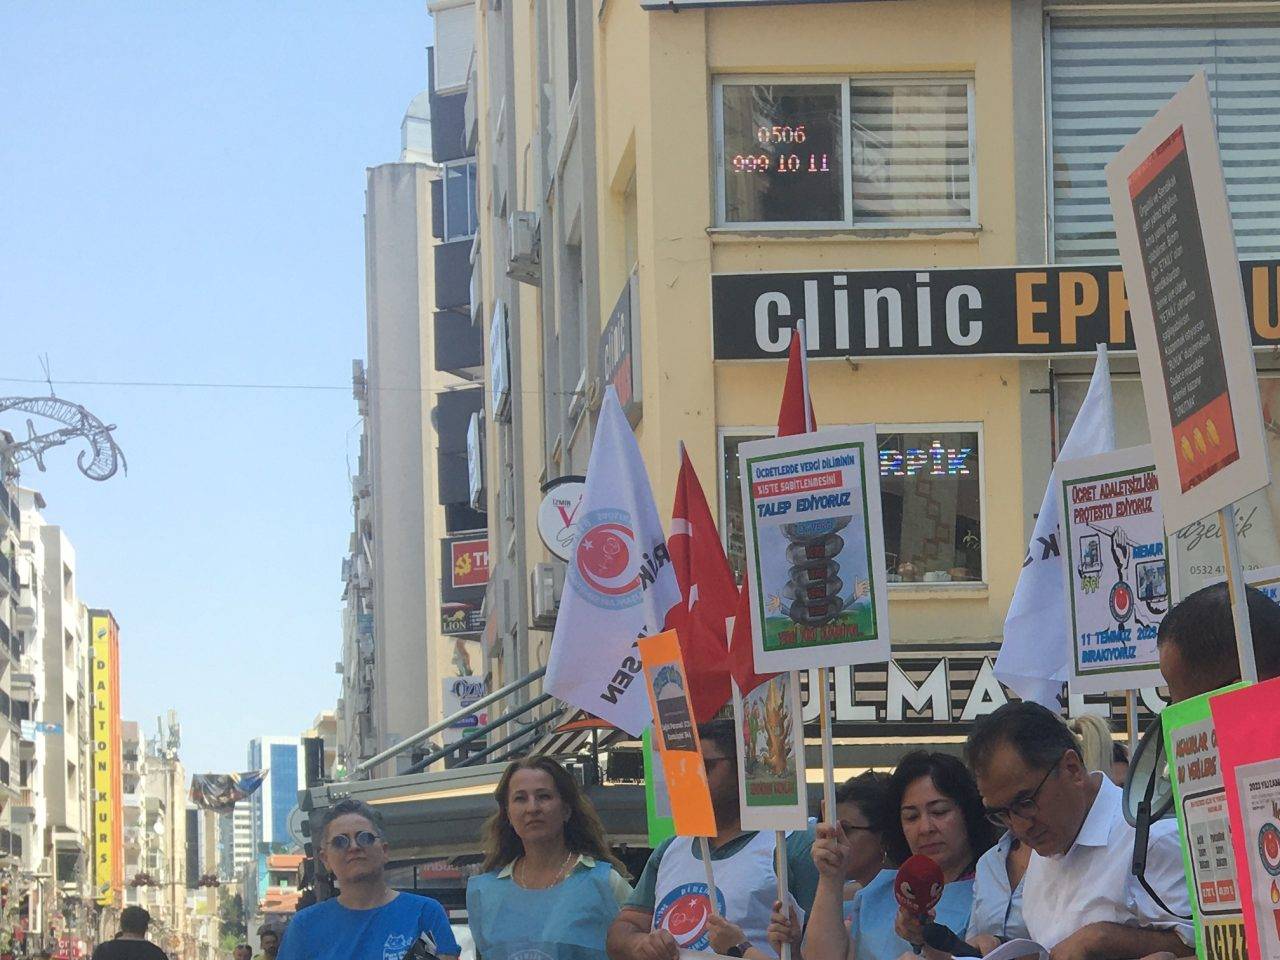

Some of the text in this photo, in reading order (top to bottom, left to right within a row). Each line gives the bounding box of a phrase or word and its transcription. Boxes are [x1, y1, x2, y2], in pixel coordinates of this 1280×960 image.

[758, 125, 806, 143] 0506
[733, 153, 829, 172] 999 10 11
[754, 272, 984, 353] clinic
[756, 461, 799, 479] ÜCRETLERDE
[800, 458, 821, 474] VERGİ
[1072, 484, 1096, 504] ÜCRET
[757, 491, 851, 518] TALEP EDİYORUZ
[1074, 496, 1152, 524] PROTESTO EDİYORUZ
[1190, 565, 1212, 575] 0532
[443, 621, 467, 632] LION
[1081, 633, 1090, 646] 11
[1095, 628, 1131, 646] TEMMUZ
[97, 661, 108, 864] DALTON KURS
